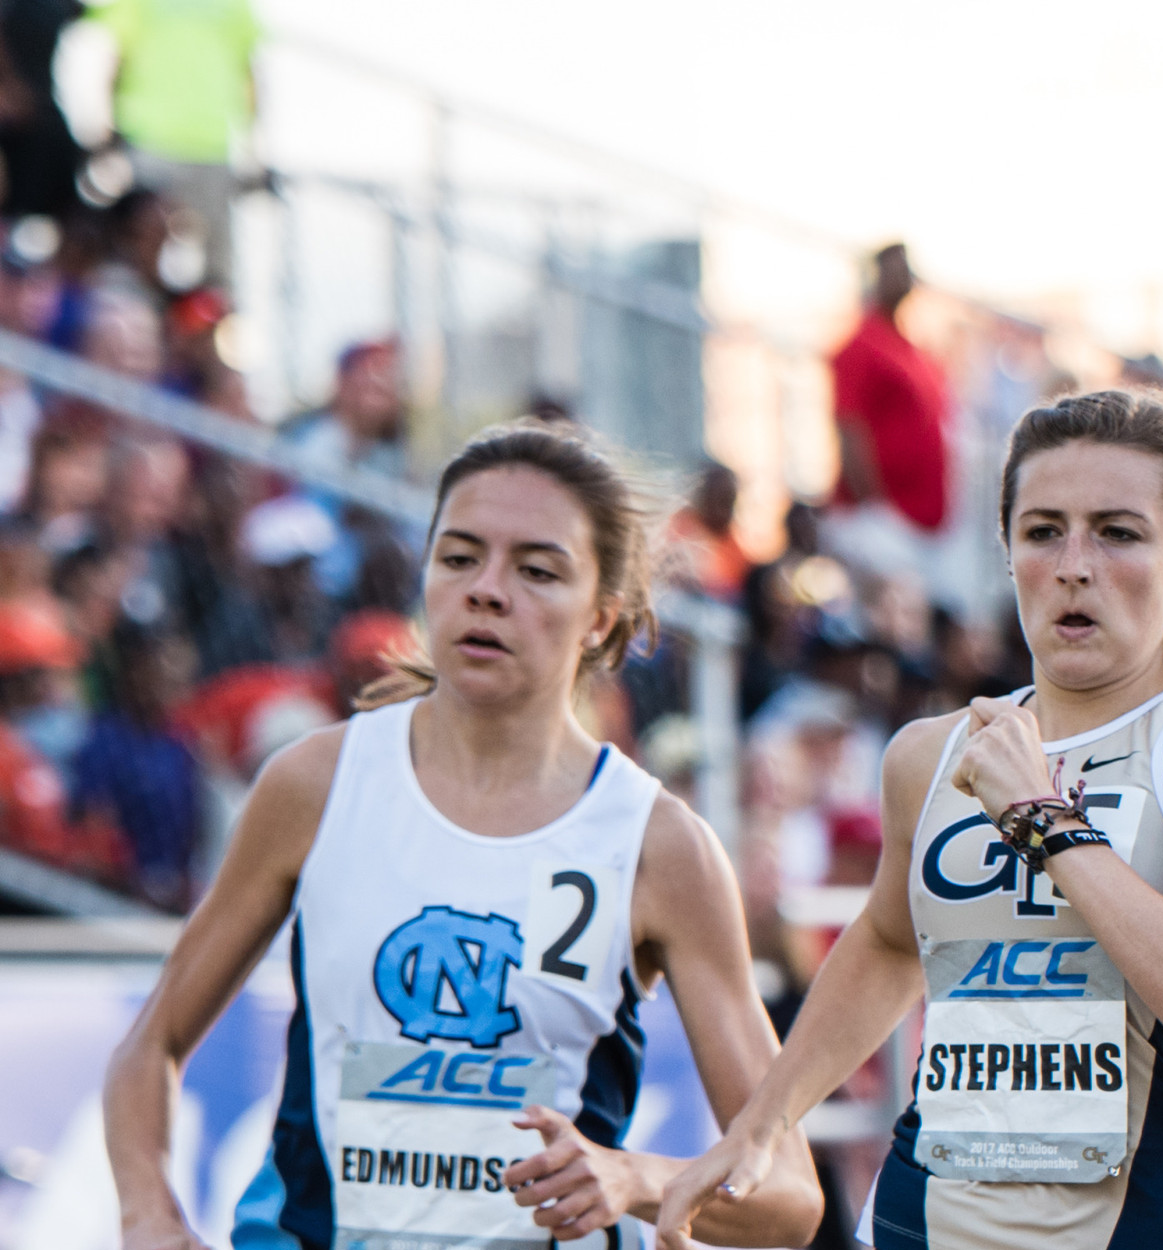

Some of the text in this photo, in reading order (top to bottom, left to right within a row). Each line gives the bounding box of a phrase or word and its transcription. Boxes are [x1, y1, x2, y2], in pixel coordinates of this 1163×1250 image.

[540, 871, 598, 981] 2
[960, 942, 1097, 986] ACC
[382, 1049, 534, 1098] ACC
[925, 1043, 1123, 1092] STEPHENS
[954, 1155, 976, 1167] Track
[985, 1156, 1006, 1168] Field
[1008, 1157, 1079, 1170] Championships
[970, 1142, 1059, 1155] 2017 ACC Outdoor
